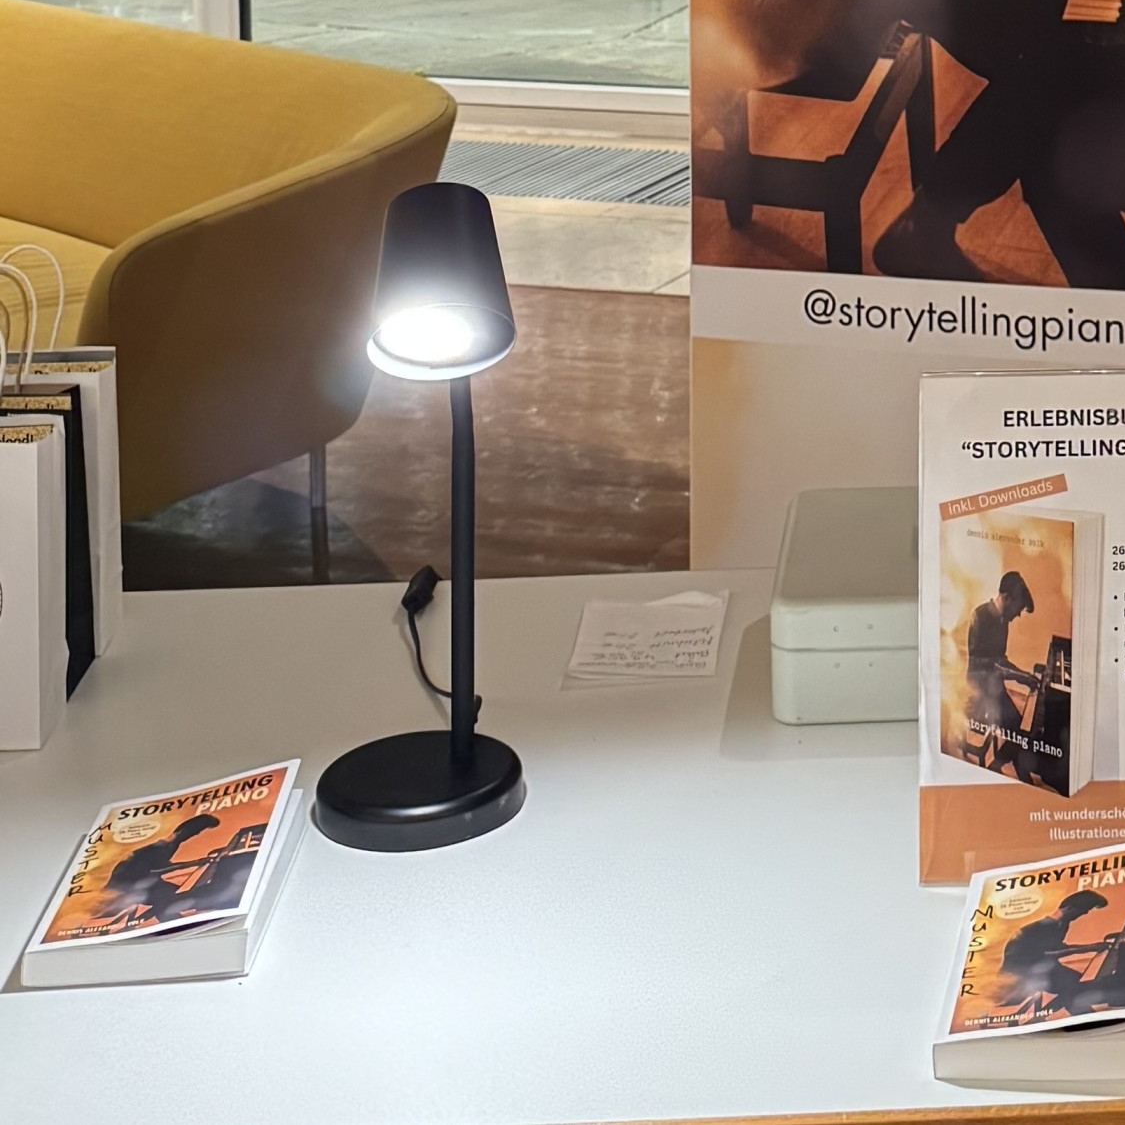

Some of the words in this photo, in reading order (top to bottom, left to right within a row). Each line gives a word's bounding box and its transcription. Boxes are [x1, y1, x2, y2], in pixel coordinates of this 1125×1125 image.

[948, 499, 975, 515] inkl.
[979, 480, 1053, 508] Downloads
[1112, 546, 1125, 555] 26
[1112, 561, 1125, 571] 26
[1033, 740, 1063, 758] piano
[118, 774, 273, 820] STORYTELLING
[195, 787, 269, 815] PIANO
[1029, 807, 1050, 821] mit
